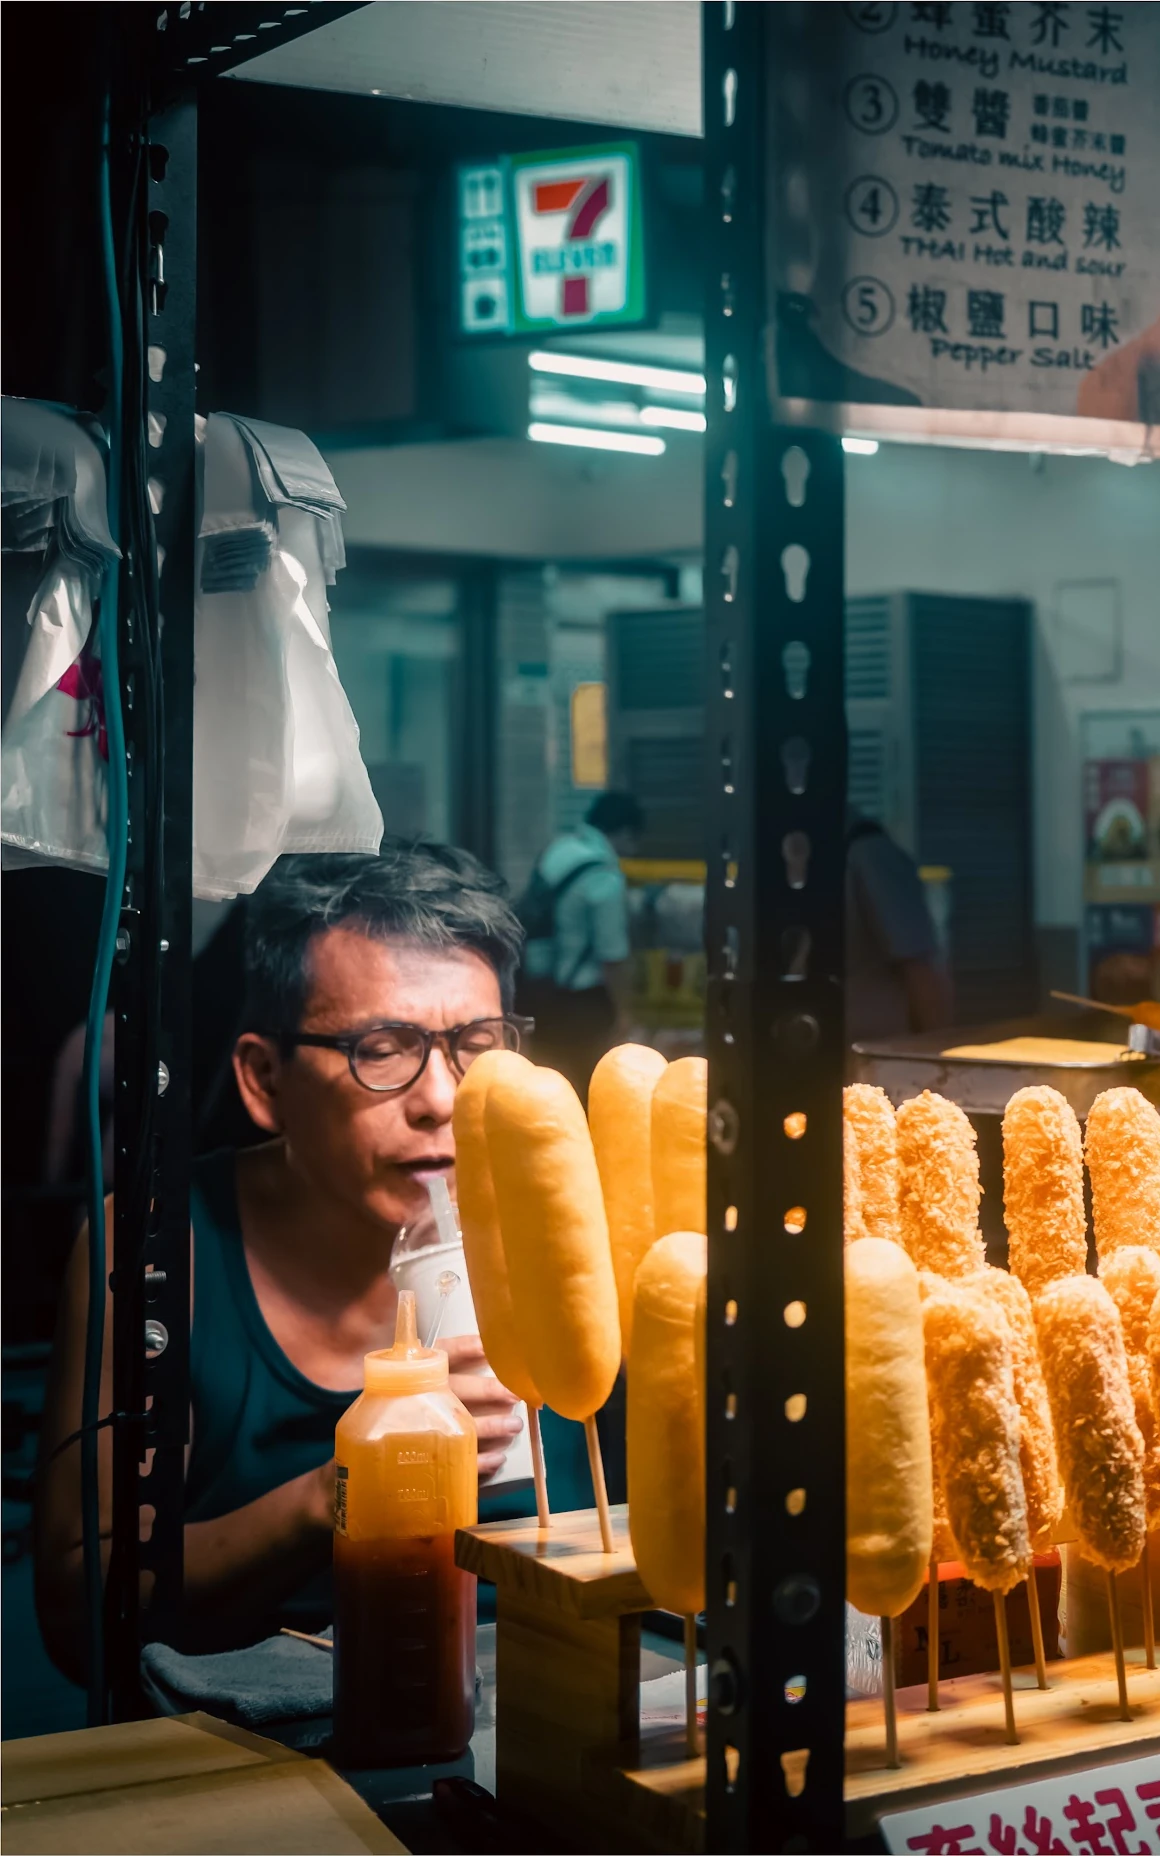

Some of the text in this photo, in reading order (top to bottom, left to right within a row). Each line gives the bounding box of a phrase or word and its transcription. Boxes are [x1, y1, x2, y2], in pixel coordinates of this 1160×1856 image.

[903, 35, 1128, 85] Honey Mustard
[911, 78, 1010, 139] 雙醬
[901, 135, 1126, 194] Tomato mix Honey
[533, 176, 611, 317] 7
[911, 182, 1122, 251] 泰式酸辣
[899, 236, 1127, 278] THAI Hot and sour
[906, 283, 1121, 349] 椒鹽口味
[929, 337, 1096, 373] Pepper Salt
